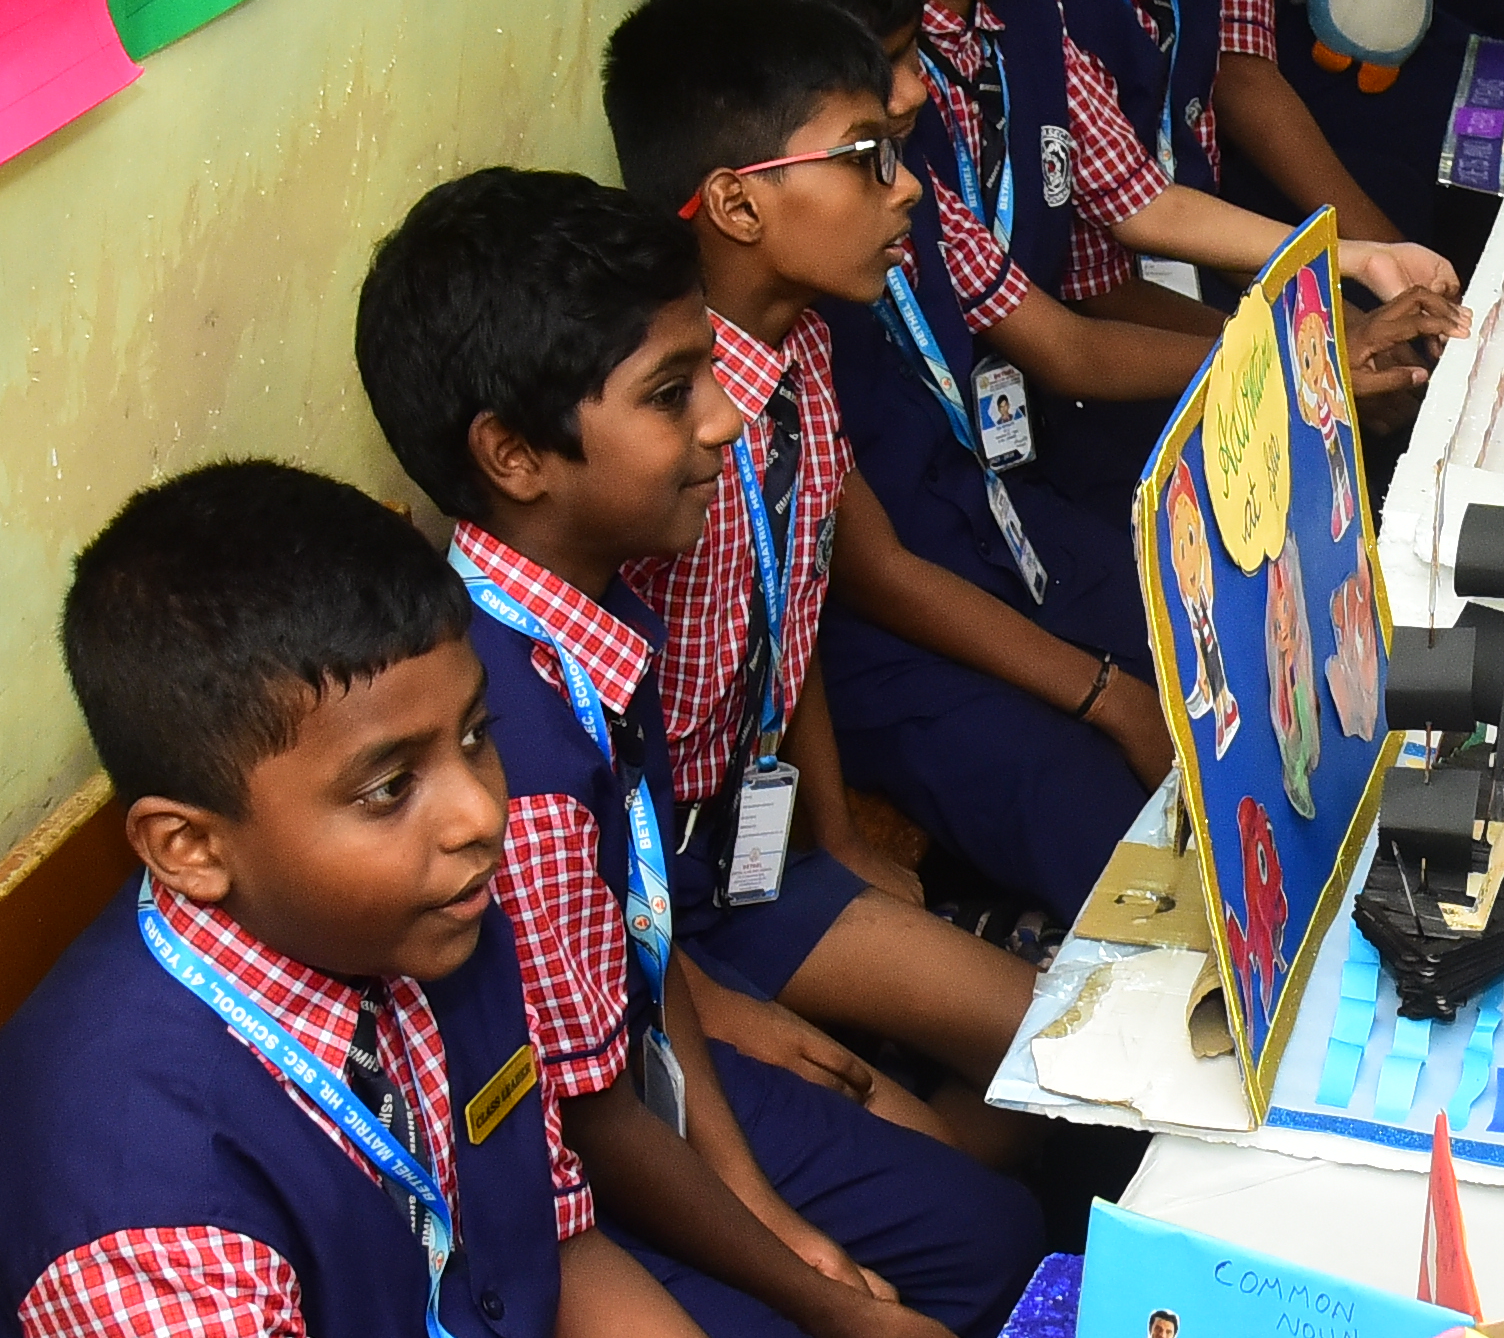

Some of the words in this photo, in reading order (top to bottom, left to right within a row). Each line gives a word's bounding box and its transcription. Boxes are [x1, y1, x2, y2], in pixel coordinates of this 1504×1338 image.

[480, 588, 529, 630] YEARS
[144, 916, 180, 970] YEARS
[181, 964, 207, 988] 41
[475, 1100, 502, 1131] CLASS
[391, 1158, 438, 1203] BETHEL
[1214, 1260, 1355, 1323] COMMON
